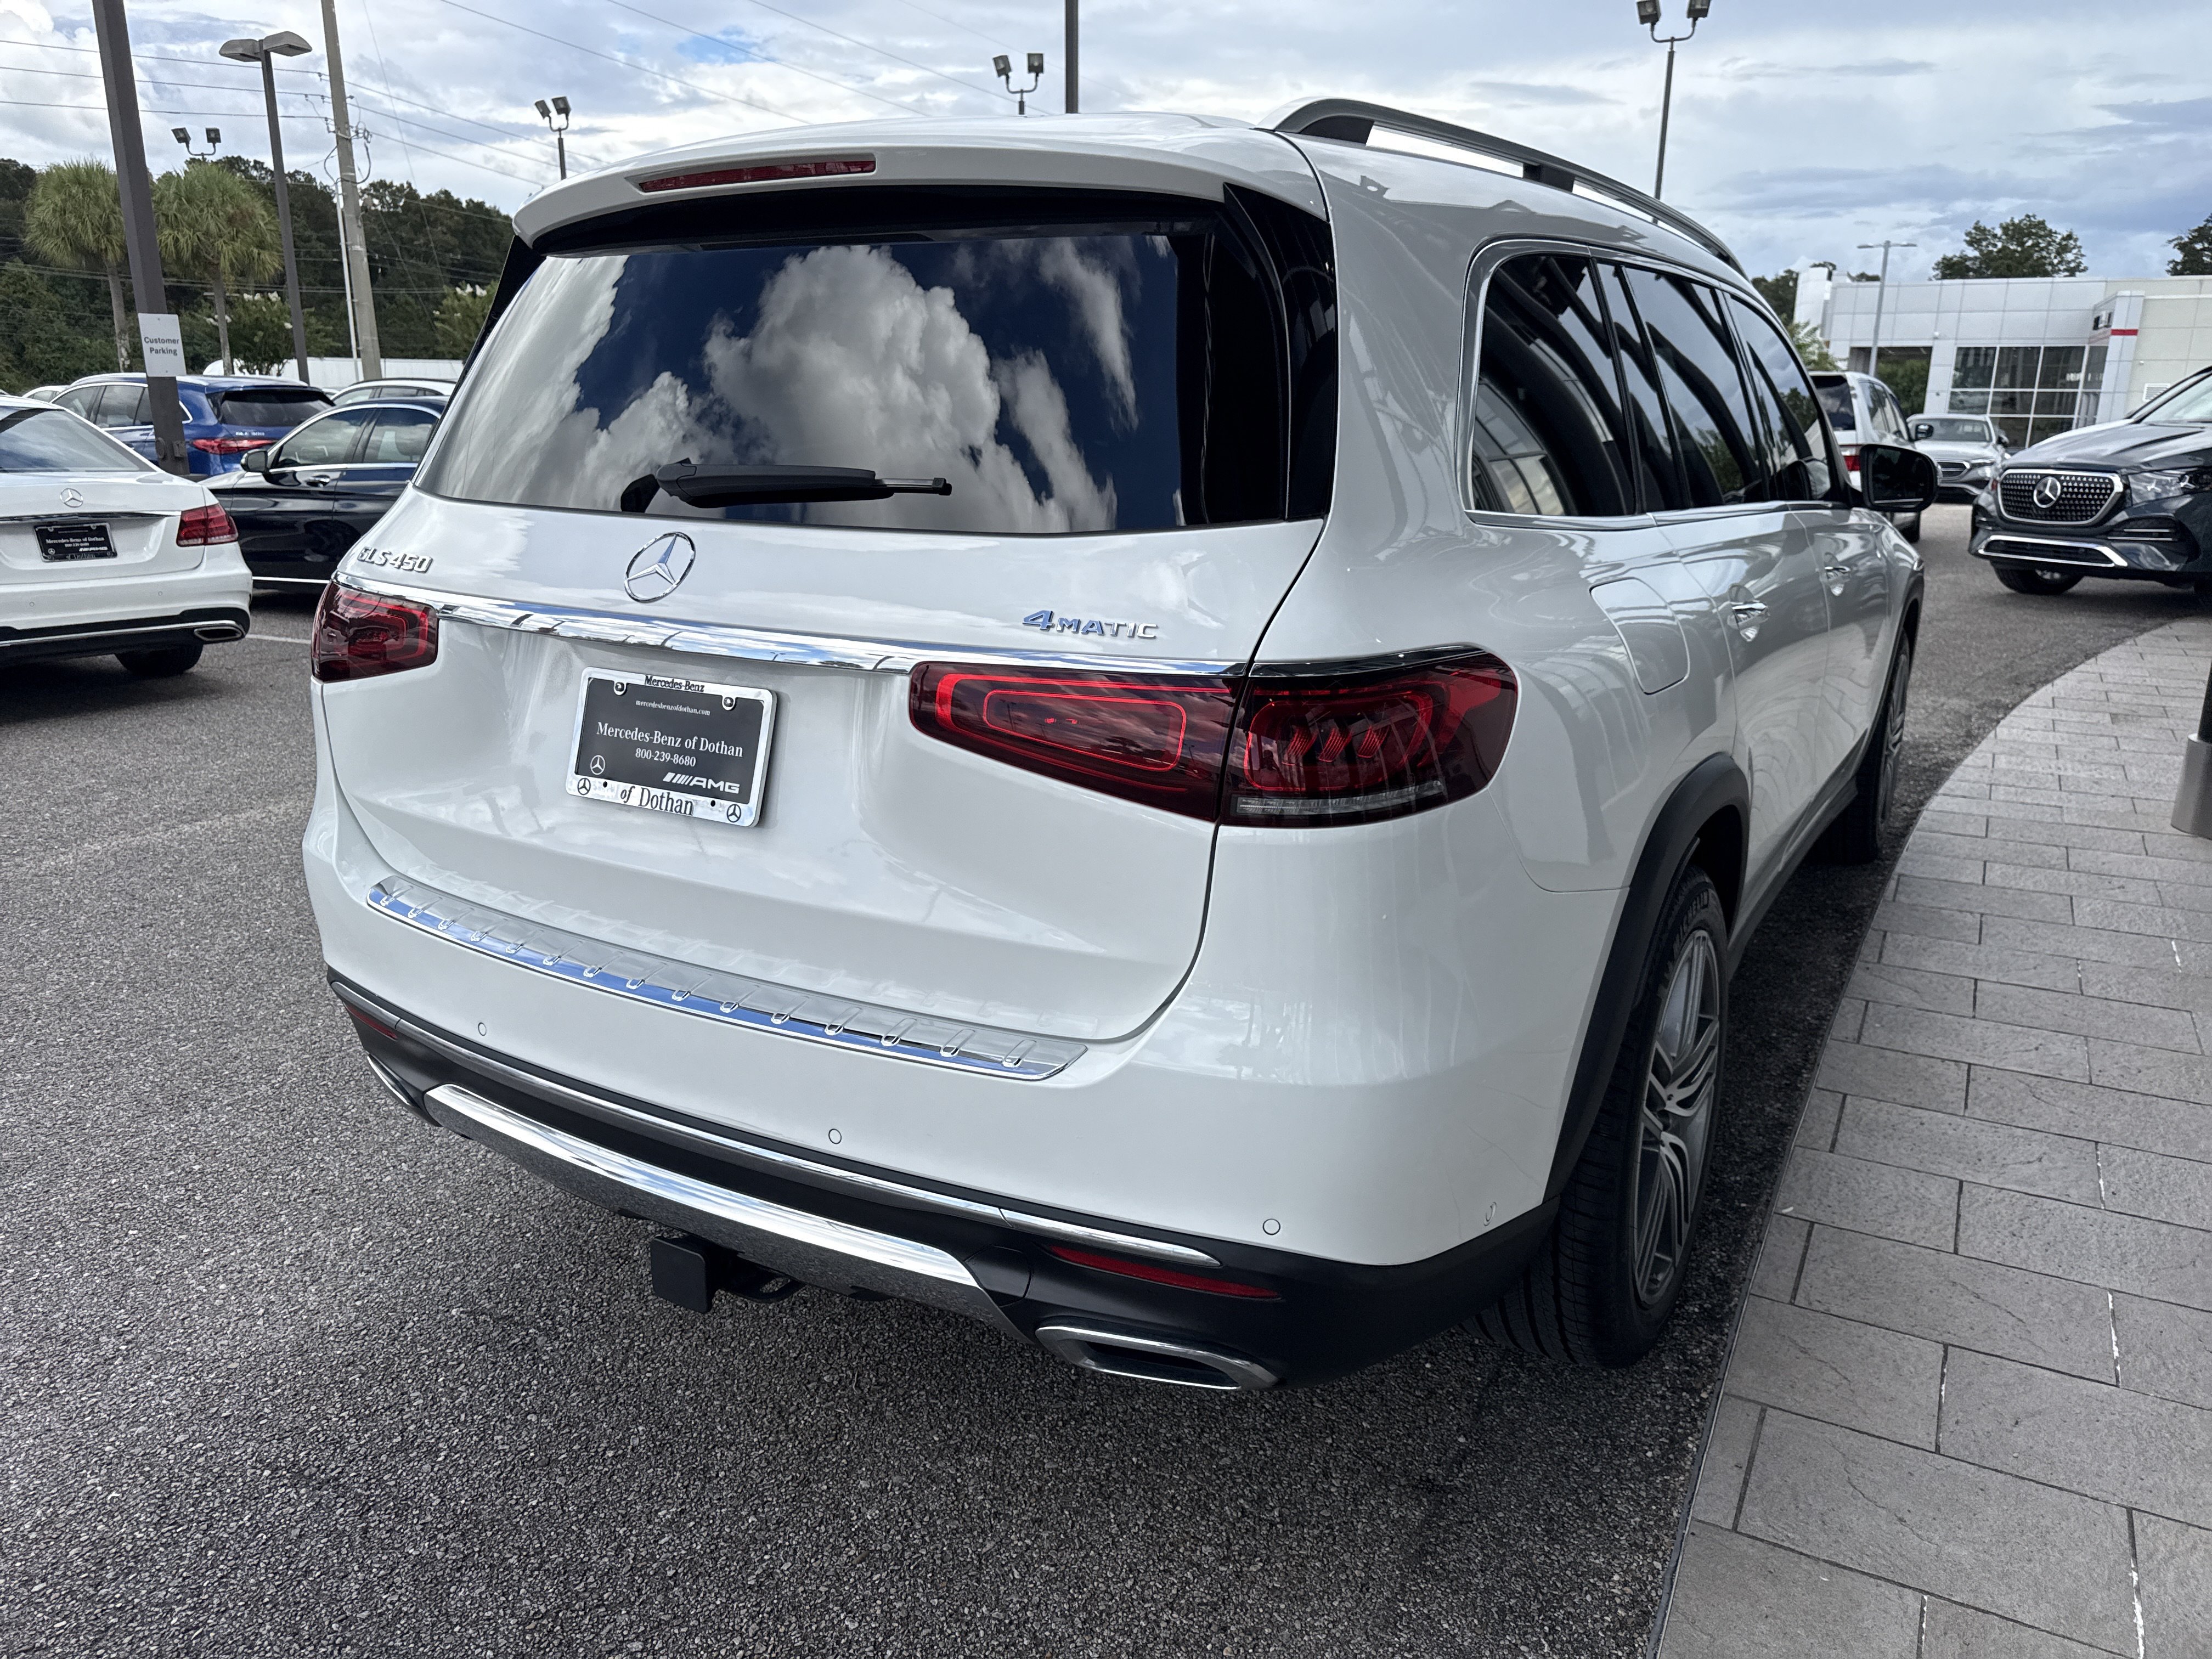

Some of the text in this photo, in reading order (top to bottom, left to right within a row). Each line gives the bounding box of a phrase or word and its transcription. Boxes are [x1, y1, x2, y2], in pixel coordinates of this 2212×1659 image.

[150, 347, 178, 356] Parking
[357, 546, 433, 573] GLS 450
[1022, 610, 1159, 640] 4MATIC
[644, 675, 705, 692] Mercedes-Benz
[635, 699, 710, 716] mercedesbenzofdothan.com
[596, 722, 743, 758] Mercedes-Benz of Dothan
[635, 748, 697, 768] 800-239-8680
[688, 777, 741, 794] AMG
[620, 786, 695, 816] of Dothan
